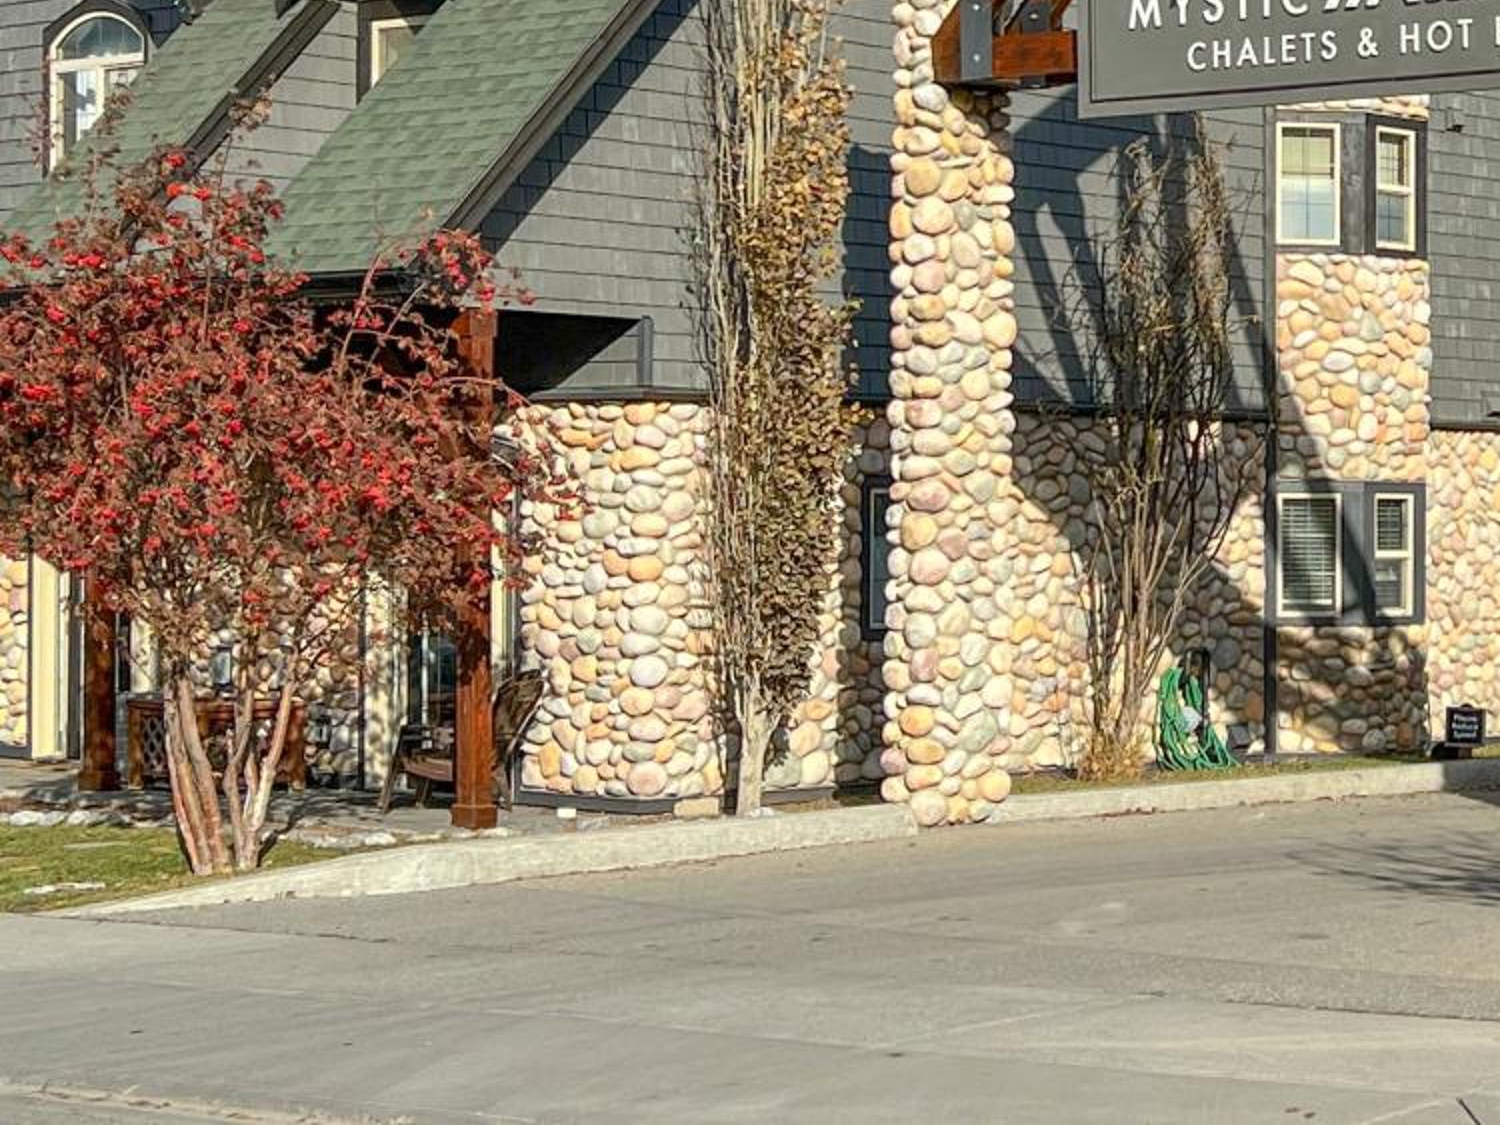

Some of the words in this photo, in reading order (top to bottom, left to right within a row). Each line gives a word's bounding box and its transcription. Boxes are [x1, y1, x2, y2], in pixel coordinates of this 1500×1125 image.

[1187, 30, 1338, 70] CHALETS
[1357, 27, 1380, 57] &
[1400, 18, 1474, 54] HOT
